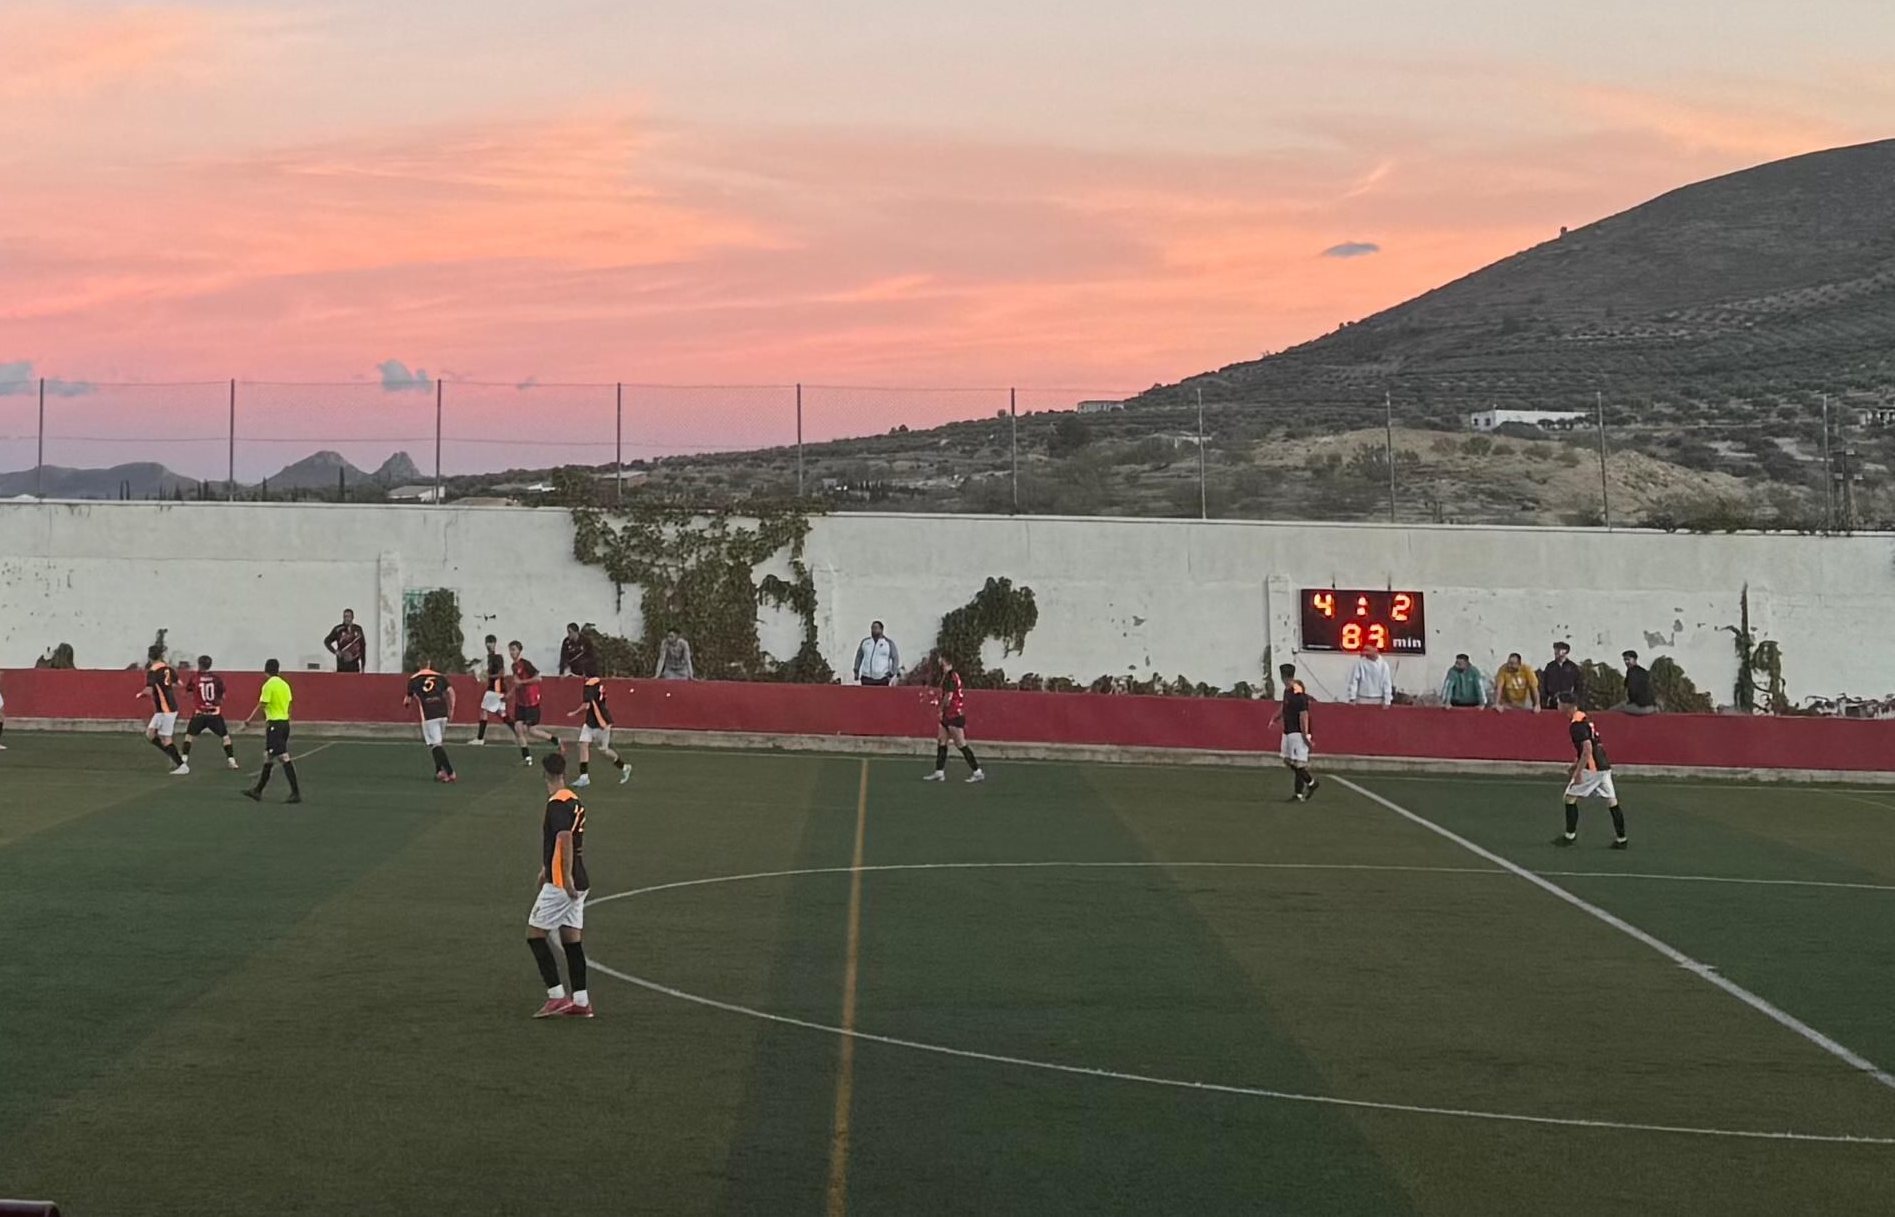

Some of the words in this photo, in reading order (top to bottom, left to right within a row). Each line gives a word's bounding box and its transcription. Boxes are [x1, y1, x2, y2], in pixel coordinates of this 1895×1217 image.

[1313, 593, 1333, 616] 4
[1391, 593, 1412, 622] 2
[1392, 636, 1422, 649] min
[198, 682, 215, 702] 10
[422, 676, 436, 693] 5
